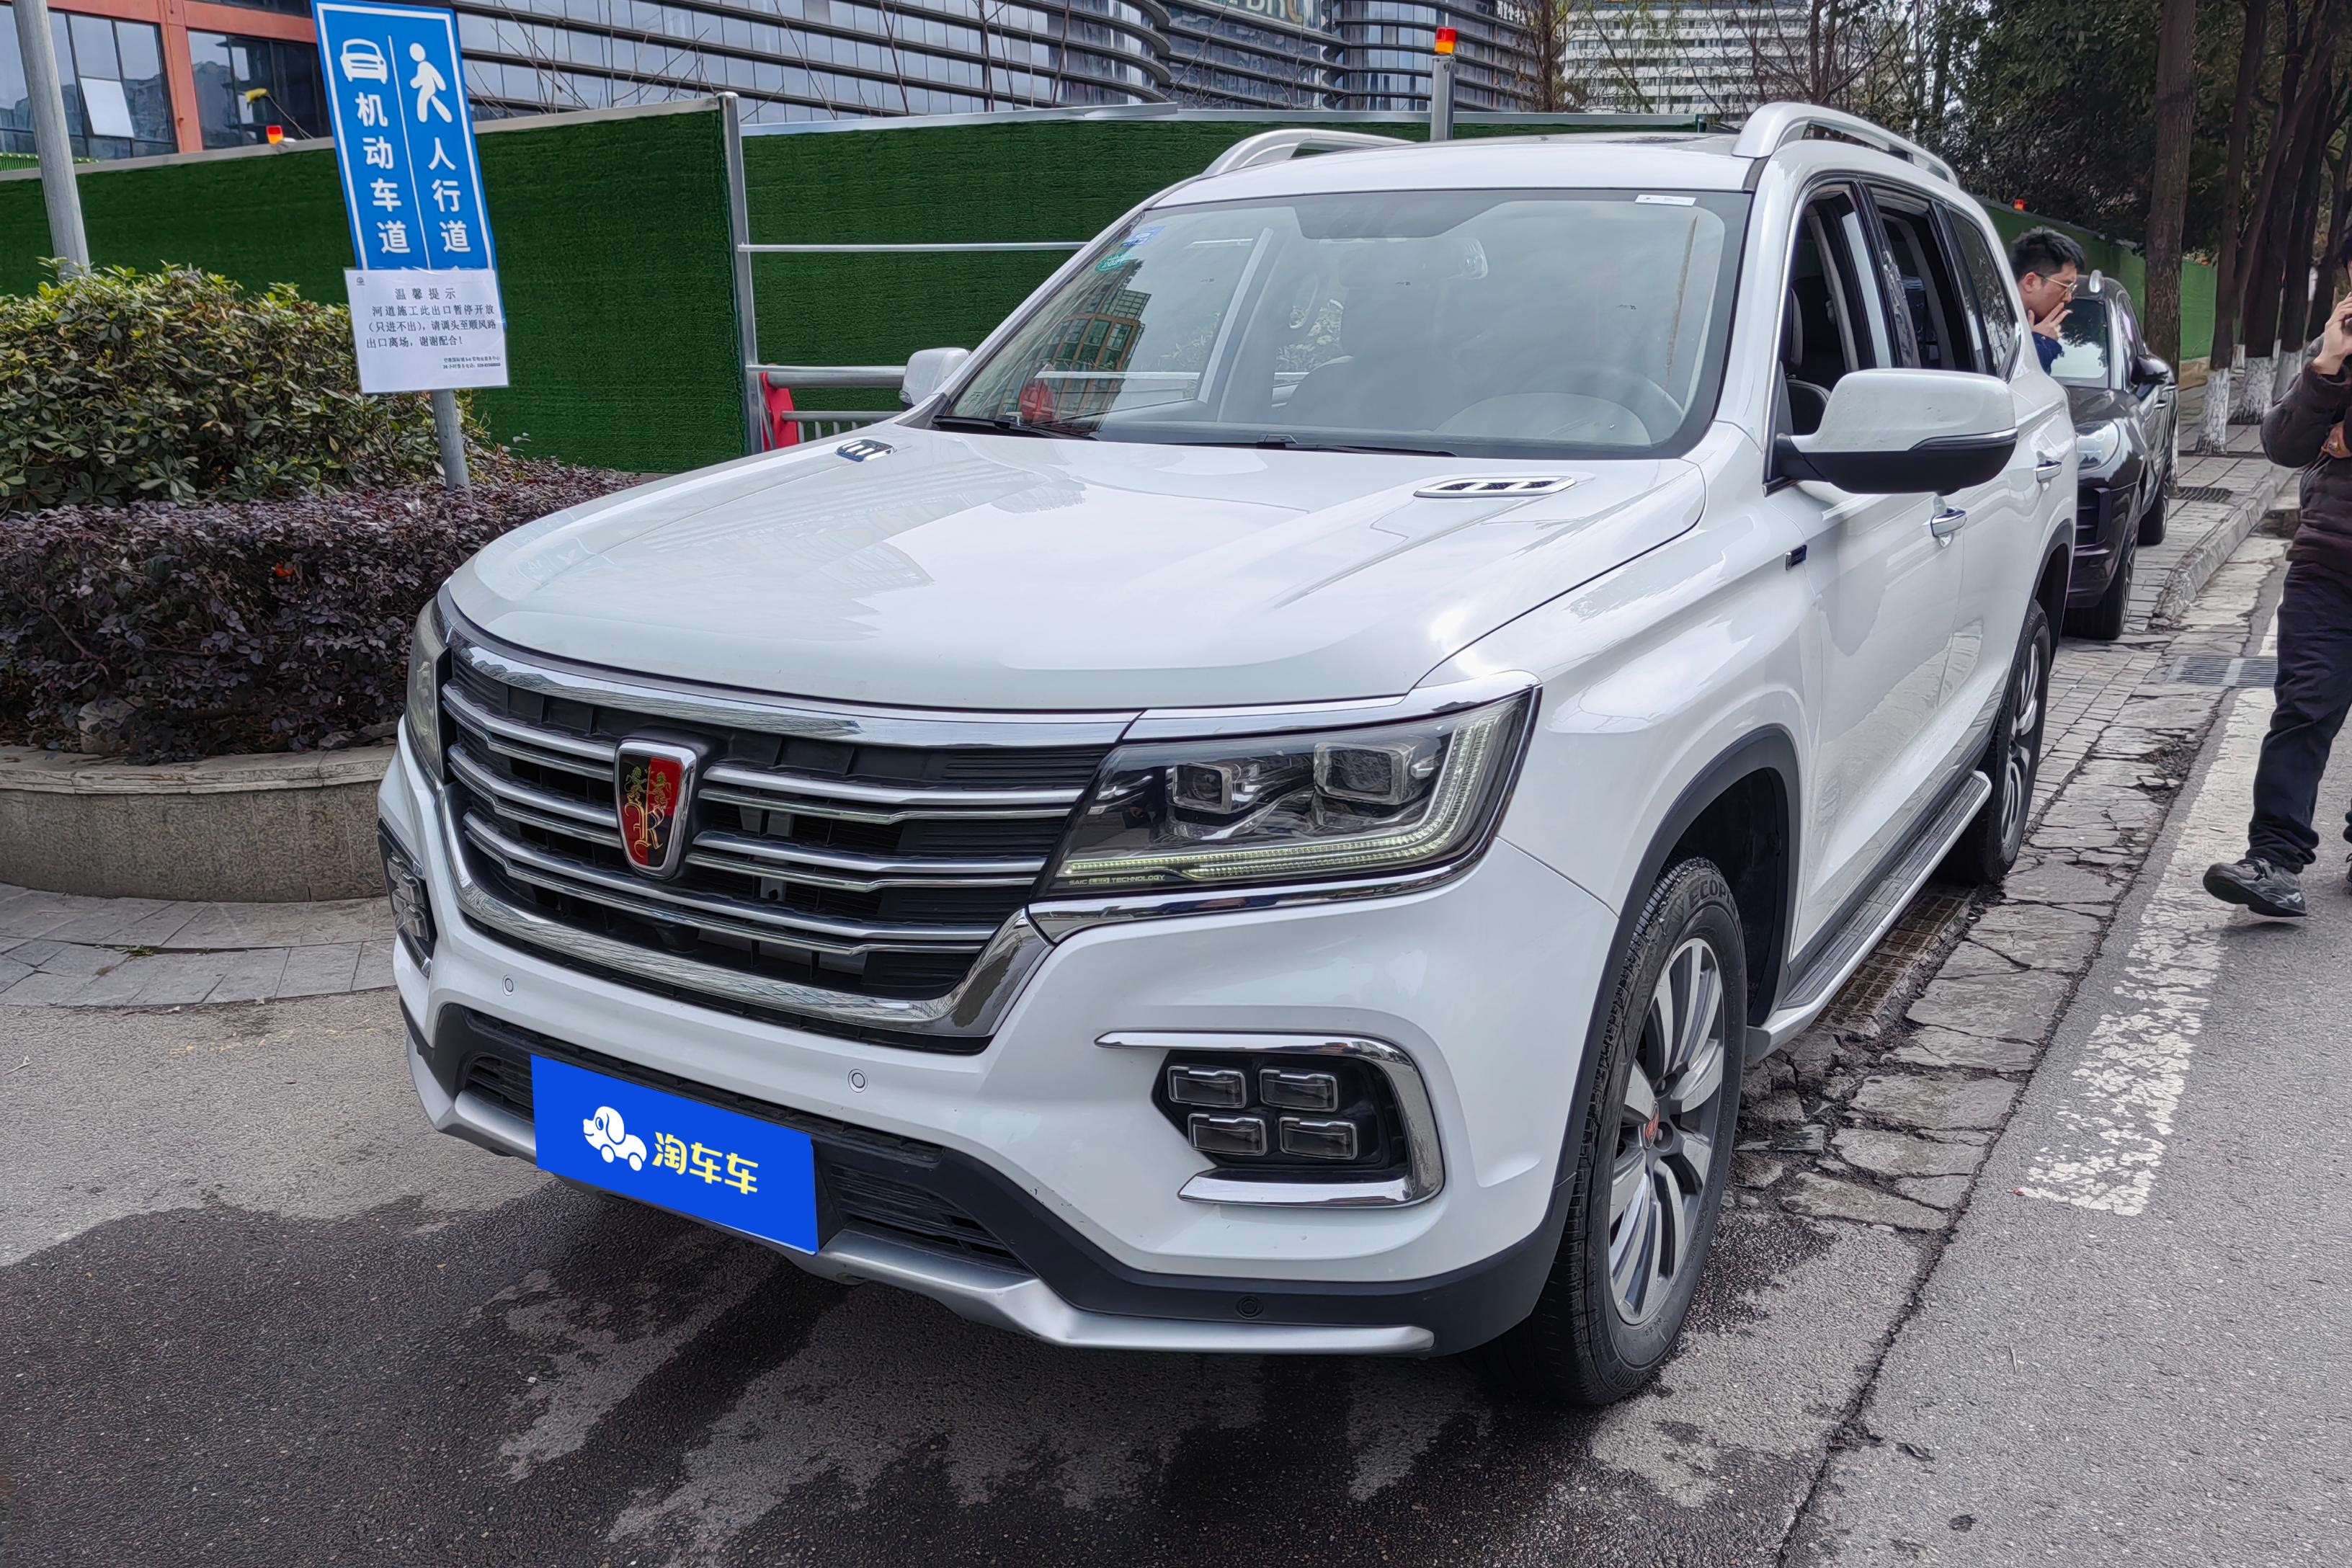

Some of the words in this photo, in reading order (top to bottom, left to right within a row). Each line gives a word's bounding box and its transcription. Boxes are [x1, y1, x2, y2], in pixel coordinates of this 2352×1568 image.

[355, 92, 411, 254] 机动车道
[428, 137, 471, 253] 人行道
[371, 303, 495, 317] 河道施工此出口暂停开放
[1111, 874, 1165, 883] TECHNOLOGY
